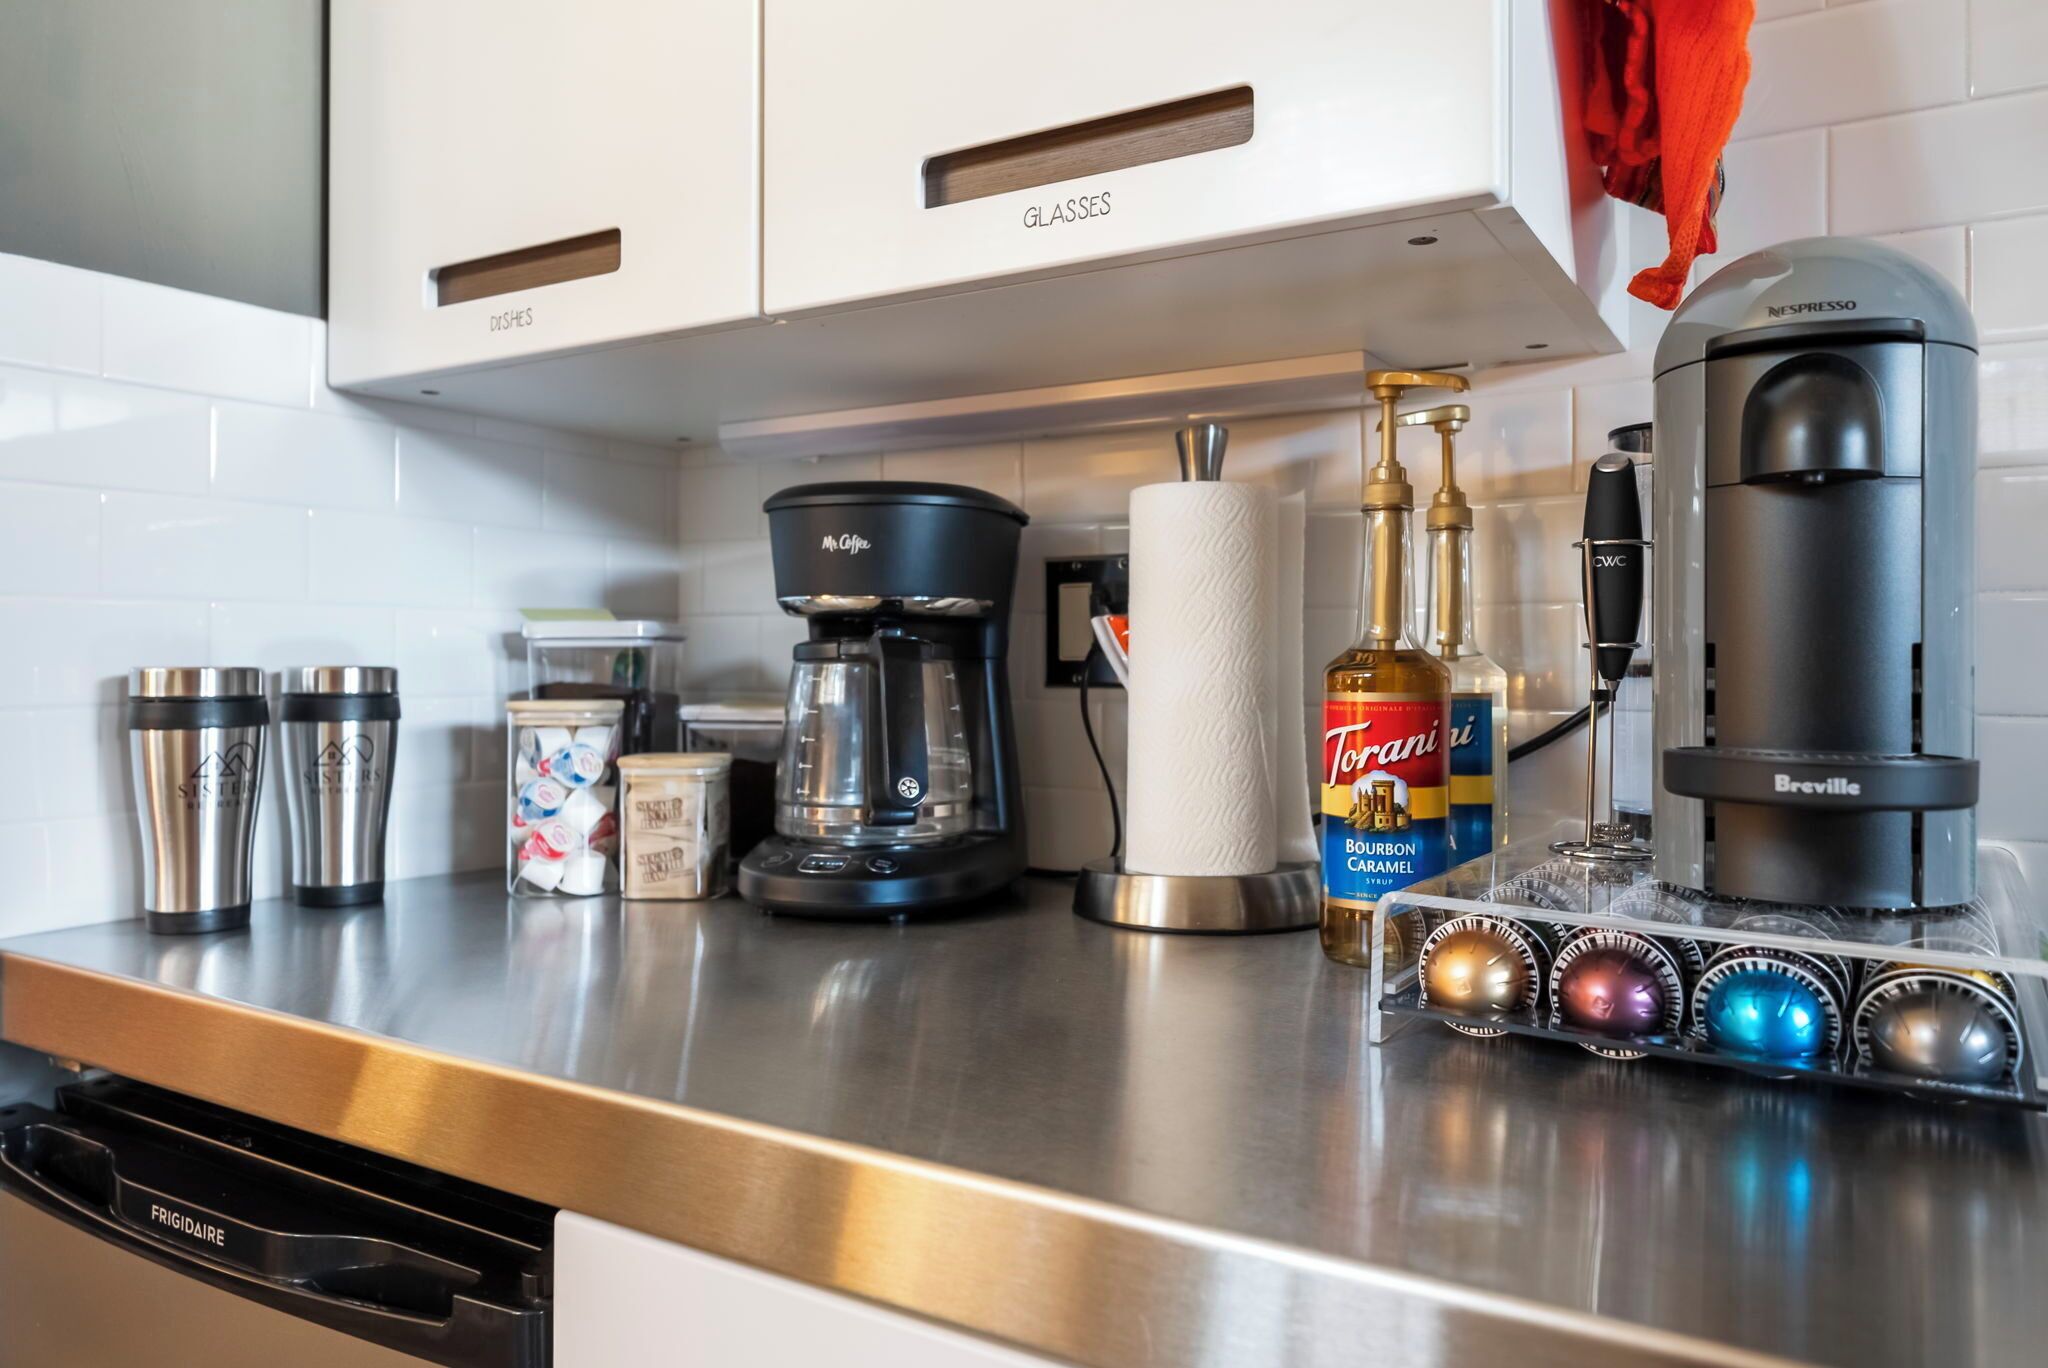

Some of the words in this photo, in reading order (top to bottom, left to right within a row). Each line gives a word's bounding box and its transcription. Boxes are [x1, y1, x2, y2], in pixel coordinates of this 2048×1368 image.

[1023, 192, 1111, 228] GLASSES
[490, 307, 533, 331] DISHES
[1765, 300, 1857, 318] NESPRESSO
[839, 533, 872, 555] Coffee
[1592, 555, 1627, 567] CWC
[1325, 719, 1439, 788] Torani
[304, 768, 382, 785] SISTRS
[1774, 773, 1861, 796] Breville
[1345, 838, 1416, 857] BOURBON
[1347, 856, 1415, 875] CARAMEL
[1365, 877, 1393, 886] SYRUP
[151, 1204, 225, 1247] FRIGIDAIRE
